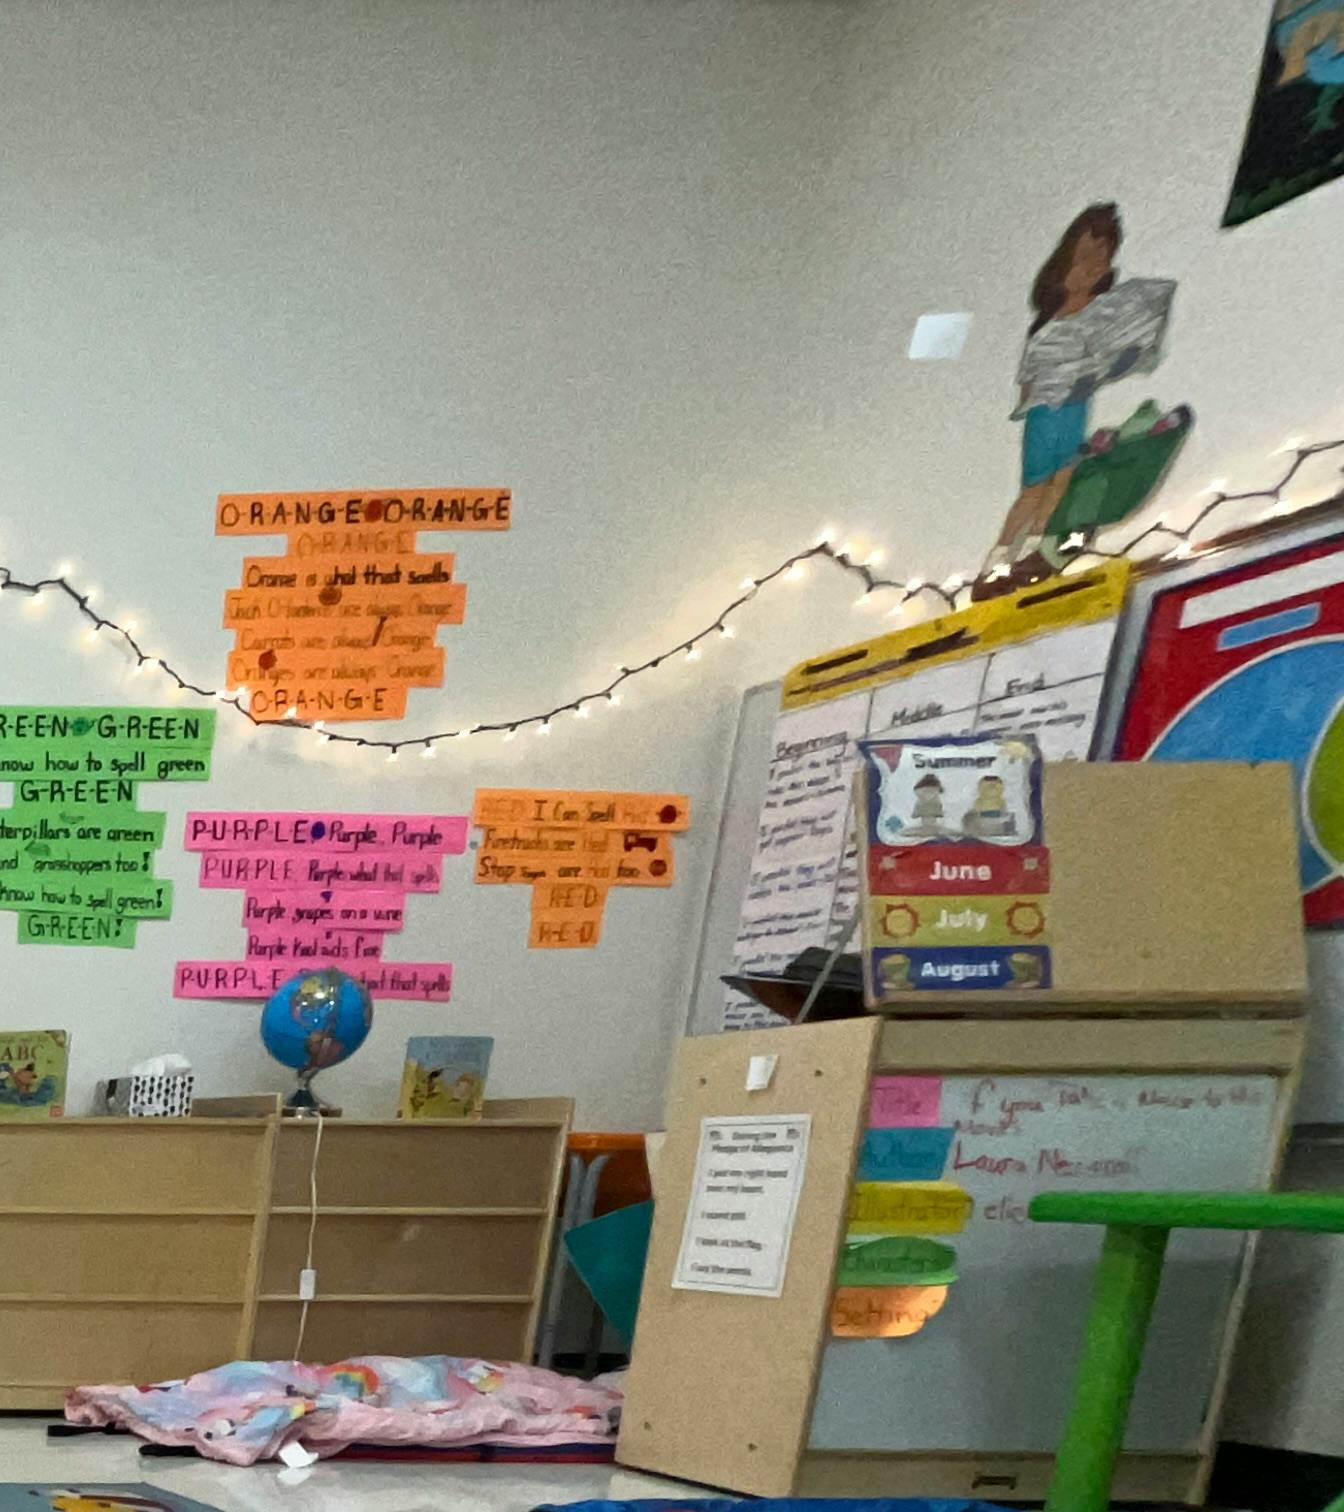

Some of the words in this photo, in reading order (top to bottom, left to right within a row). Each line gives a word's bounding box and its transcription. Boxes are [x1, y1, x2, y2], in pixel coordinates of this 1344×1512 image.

[364, 562, 402, 584] that
[1006, 672, 1045, 696] End
[97, 714, 200, 740] G-R-E-E-N
[45, 751, 79, 772] how
[85, 752, 102, 771] to
[110, 752, 145, 776] spell
[157, 759, 205, 780] green
[913, 753, 998, 768] Summer
[20, 780, 133, 804] G-R-E-E-N
[534, 799, 548, 821] I
[76, 824, 101, 840] are
[106, 828, 155, 843] green
[391, 821, 444, 850] Purple
[308, 859, 346, 886] Purple
[477, 855, 516, 881] Stop
[928, 862, 992, 881] June
[0, 881, 35, 902] know
[41, 884, 66, 905] how
[69, 886, 82, 905] to
[86, 888, 113, 911] spell
[246, 897, 286, 925] Purple
[291, 907, 334, 925] grapes
[933, 908, 989, 934] July
[247, 935, 287, 961] Purple
[388, 970, 417, 991] that
[920, 959, 1001, 983] August
[0, 1044, 45, 1061] ABC
